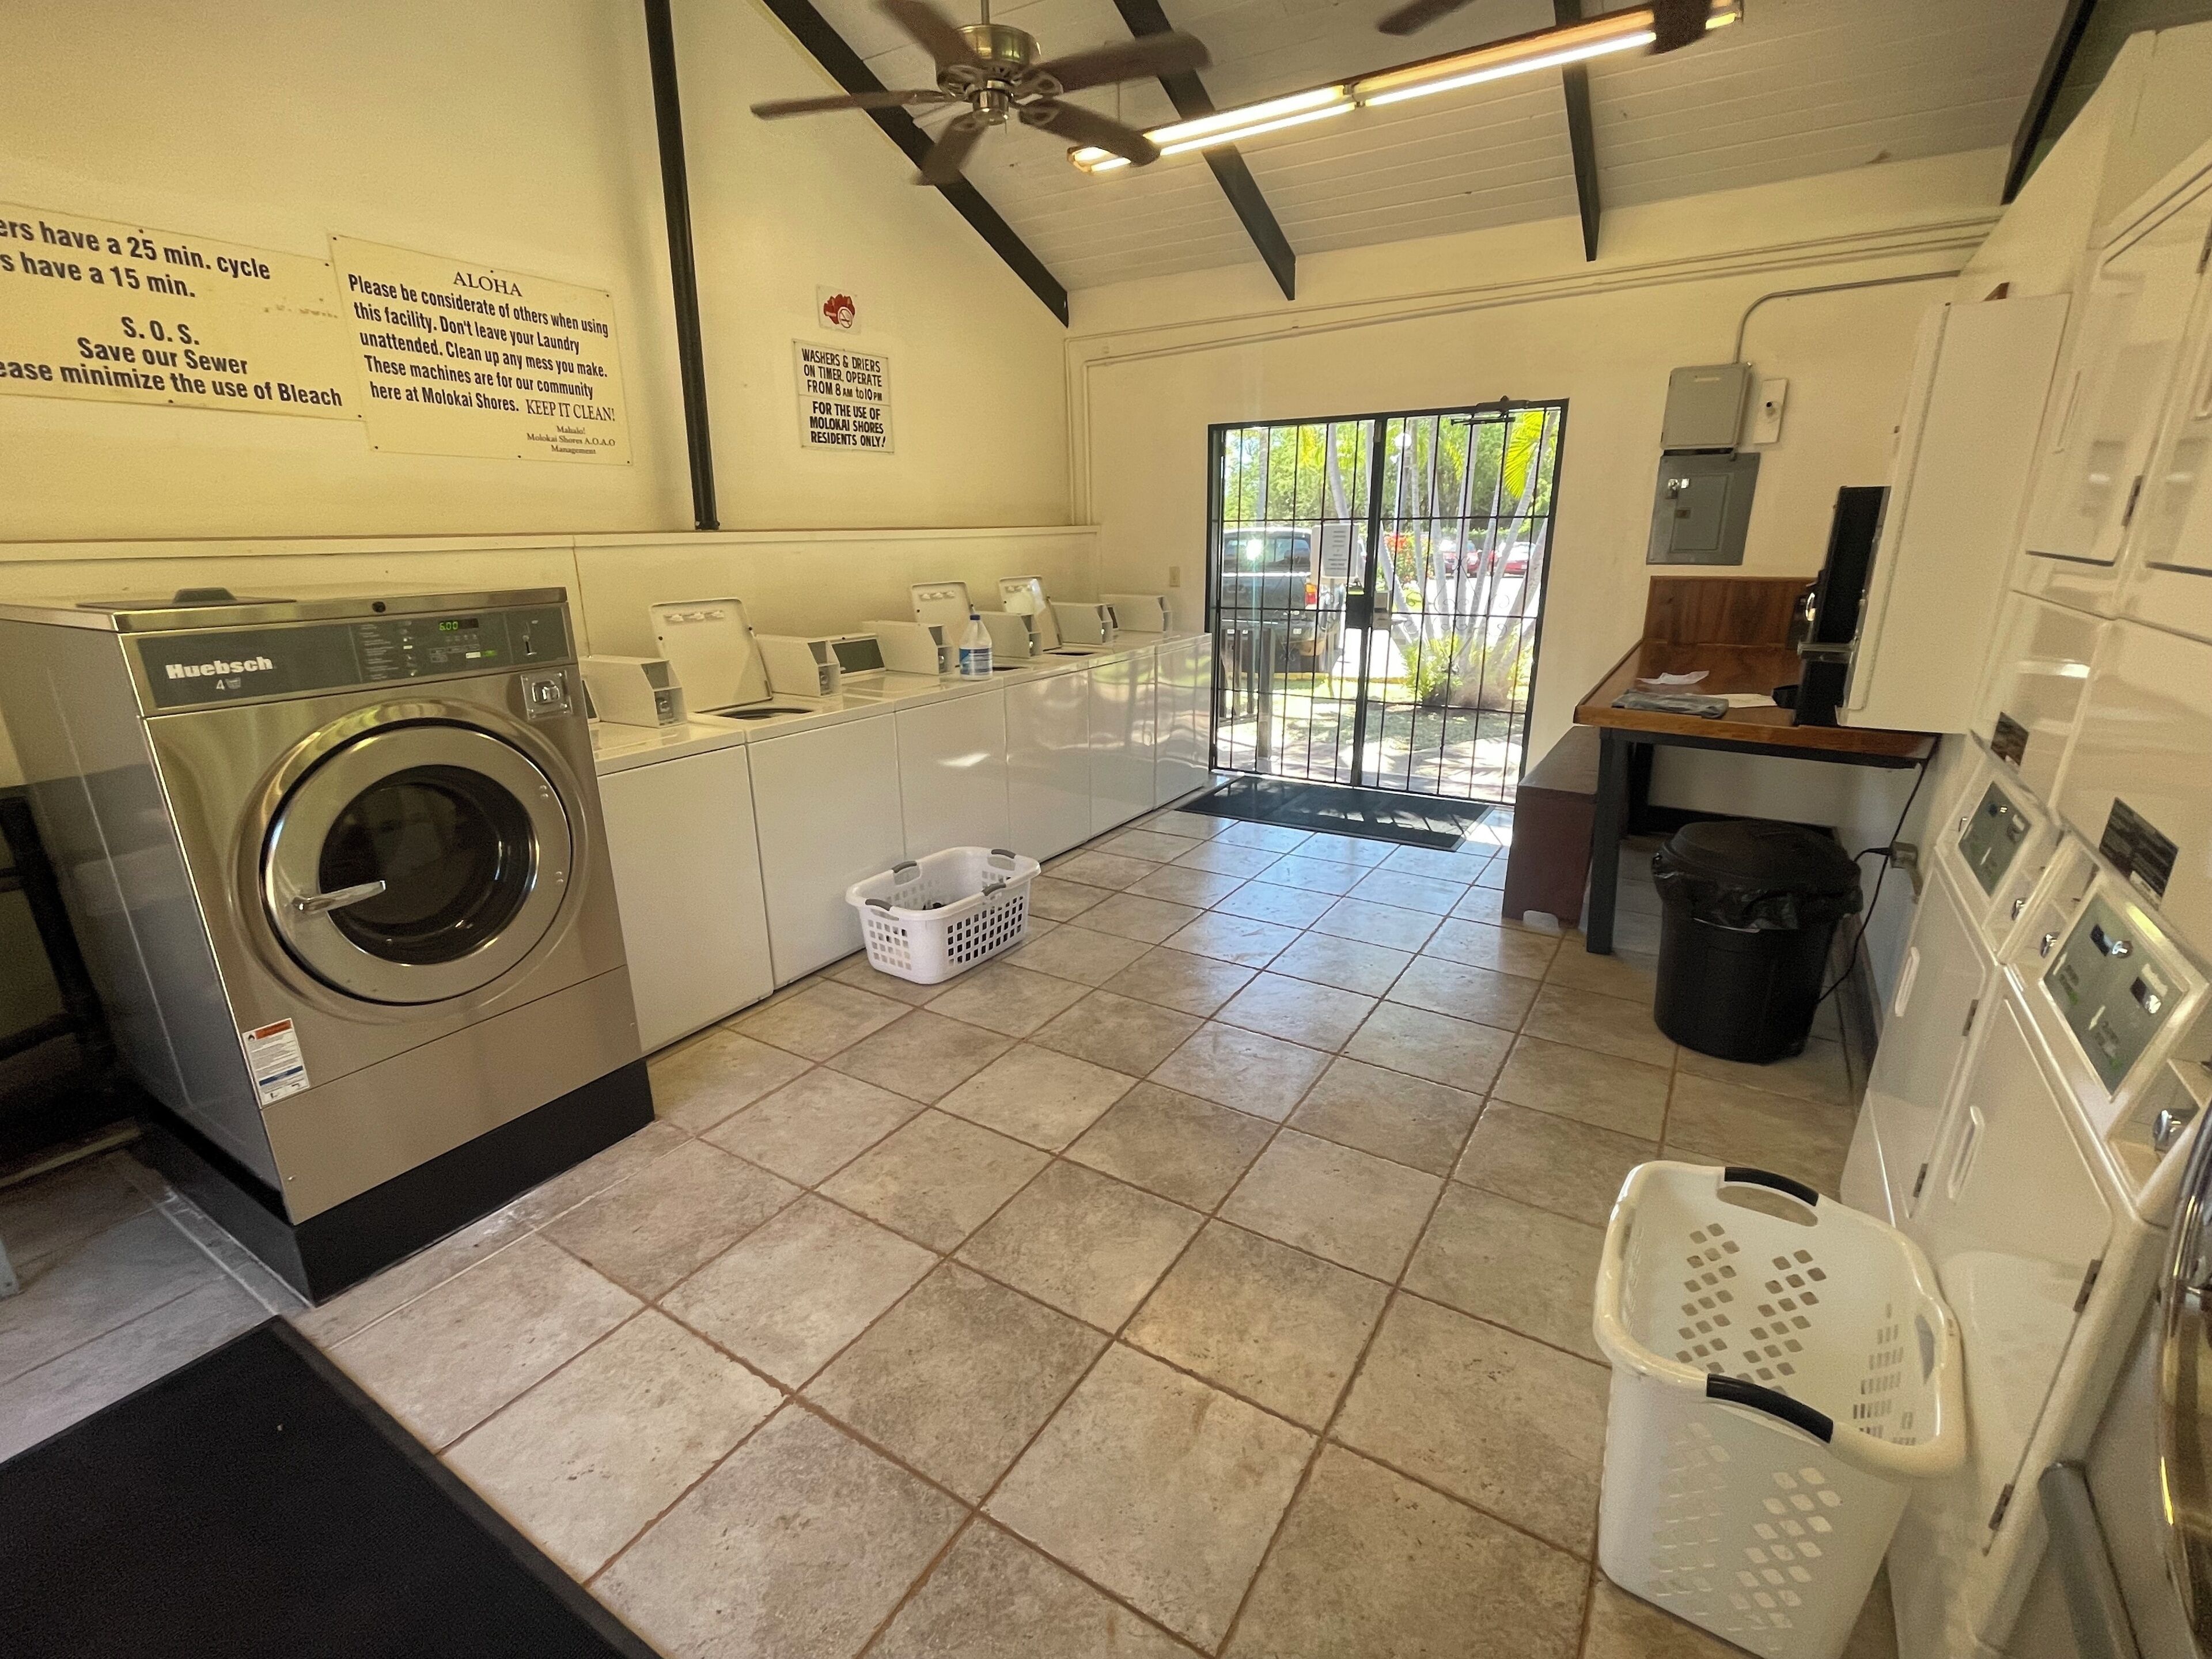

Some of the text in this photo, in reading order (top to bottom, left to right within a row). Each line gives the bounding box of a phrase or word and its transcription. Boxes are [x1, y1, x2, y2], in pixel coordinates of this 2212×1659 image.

[39, 221, 100, 251] have
[107, 237, 122, 255] a
[127, 236, 157, 260] 25
[163, 245, 211, 270] min.
[217, 256, 271, 280] cycle
[19, 251, 82, 281] have
[89, 267, 105, 285] a
[109, 266, 140, 289] 15
[146, 274, 195, 297] min.
[453, 271, 523, 297] ALOHA
[348, 274, 608, 338] Please be considerate of others when using
[354, 302, 381, 322] this
[384, 306, 437, 333] facility.
[439, 315, 473, 336] Don't
[474, 321, 507, 342] leave
[509, 330, 534, 346] your
[536, 331, 579, 355] Laundry
[77, 337, 248, 374] Save our Sewer
[359, 332, 608, 377] unattended. Clean up any mess you make.
[802, 348, 881, 373] WASHERS & DRIERS
[59, 363, 165, 391] minimize
[170, 373, 206, 394] the
[211, 380, 248, 398] use
[254, 381, 273, 400] of
[277, 382, 343, 407] Bleach
[363, 354, 593, 400] These machines are for our community
[804, 364, 815, 378] ON
[846, 370, 882, 387] OPERATE
[370, 381, 615, 422] here at Molokai Shores. KEEP IT CLEAN!
[807, 379, 833, 395] FROM
[835, 383, 841, 396] 8
[843, 388, 853, 397] AM
[873, 392, 882, 401] PM
[813, 401, 881, 421] FOR THE USE OF
[556, 425, 586, 435] Mahalo!
[810, 416, 884, 434] MOLOKAI SHORES
[527, 433, 557, 442] Molokai
[559, 435, 582, 444] Shores
[551, 444, 596, 454] Management
[810, 431, 886, 448] RESIDENTS ONLY!
[165, 656, 273, 679] Huebsch
